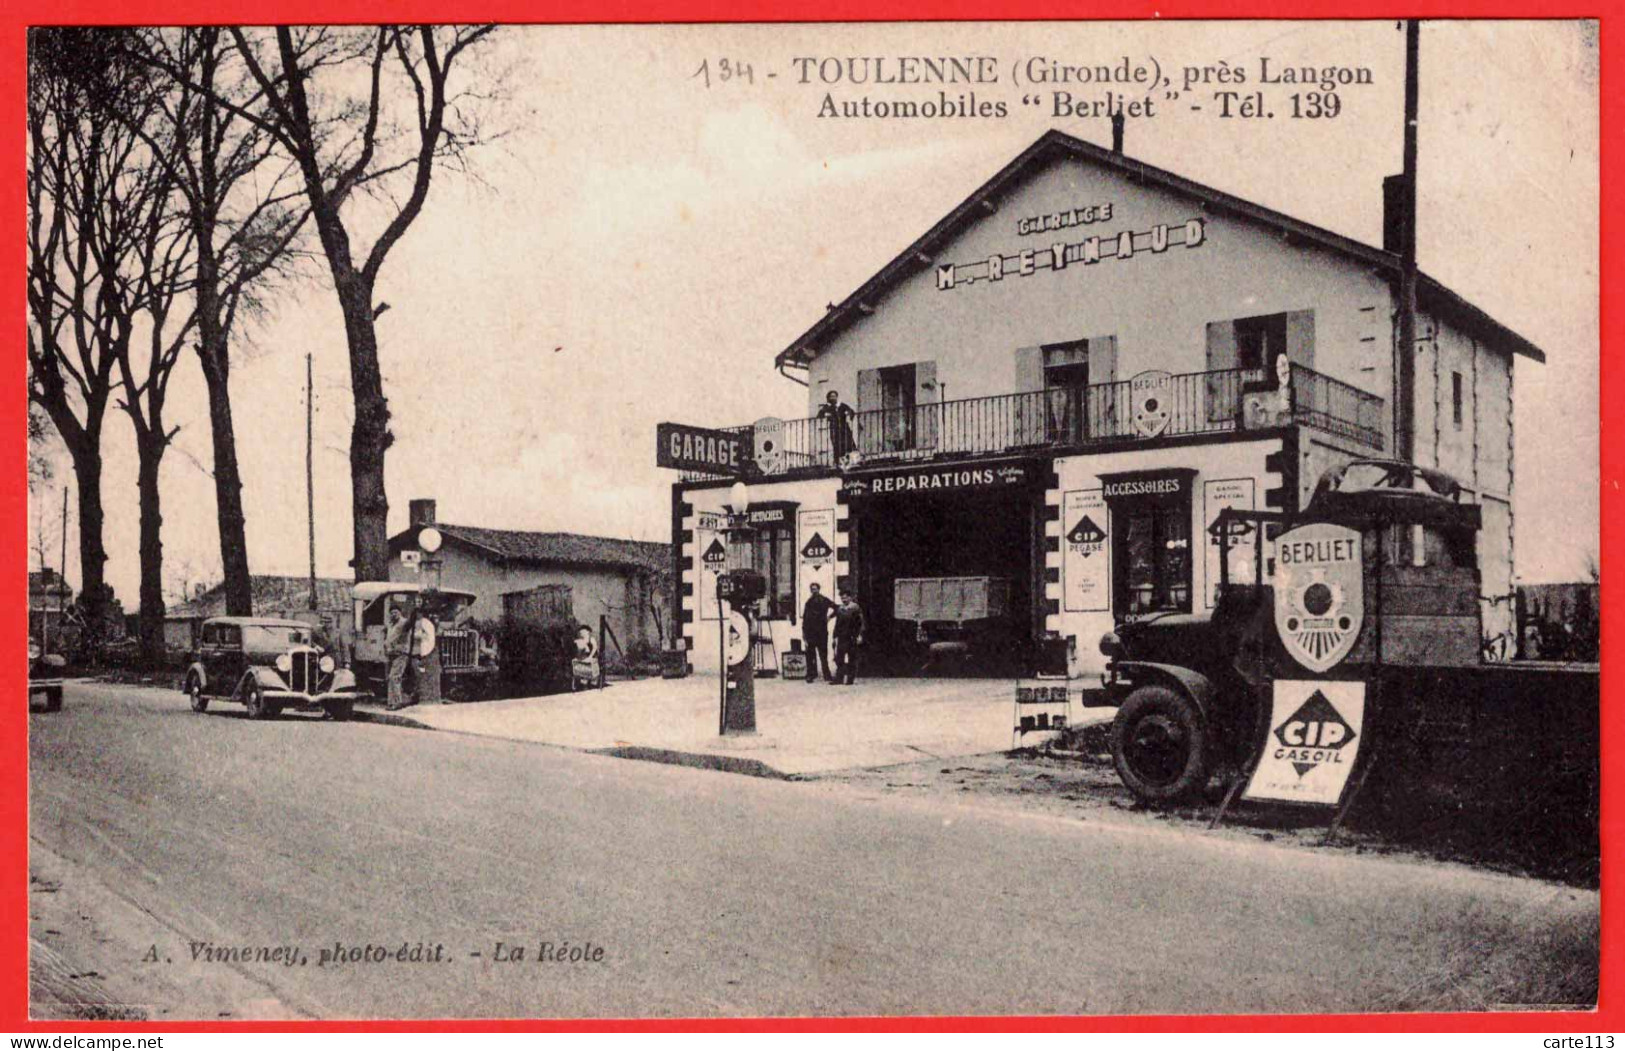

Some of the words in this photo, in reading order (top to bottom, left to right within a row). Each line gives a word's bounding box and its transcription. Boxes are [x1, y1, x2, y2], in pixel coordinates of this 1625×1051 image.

[691, 57, 754, 88] 134
[1018, 203, 1112, 236] GARAGE
[670, 432, 739, 467] GARAGE
[872, 469, 994, 493] REPARATIONS
[1104, 478, 1180, 497] ACCESSOIRES
[1074, 531, 1098, 541] CIP
[707, 552, 725, 562] CIP
[807, 547, 826, 556] CIP
[1069, 543, 1104, 553] PEGASE
[1282, 539, 1355, 564] BERLIET
[1284, 720, 1346, 747] CIP
[1274, 748, 1342, 763] GASOIL
